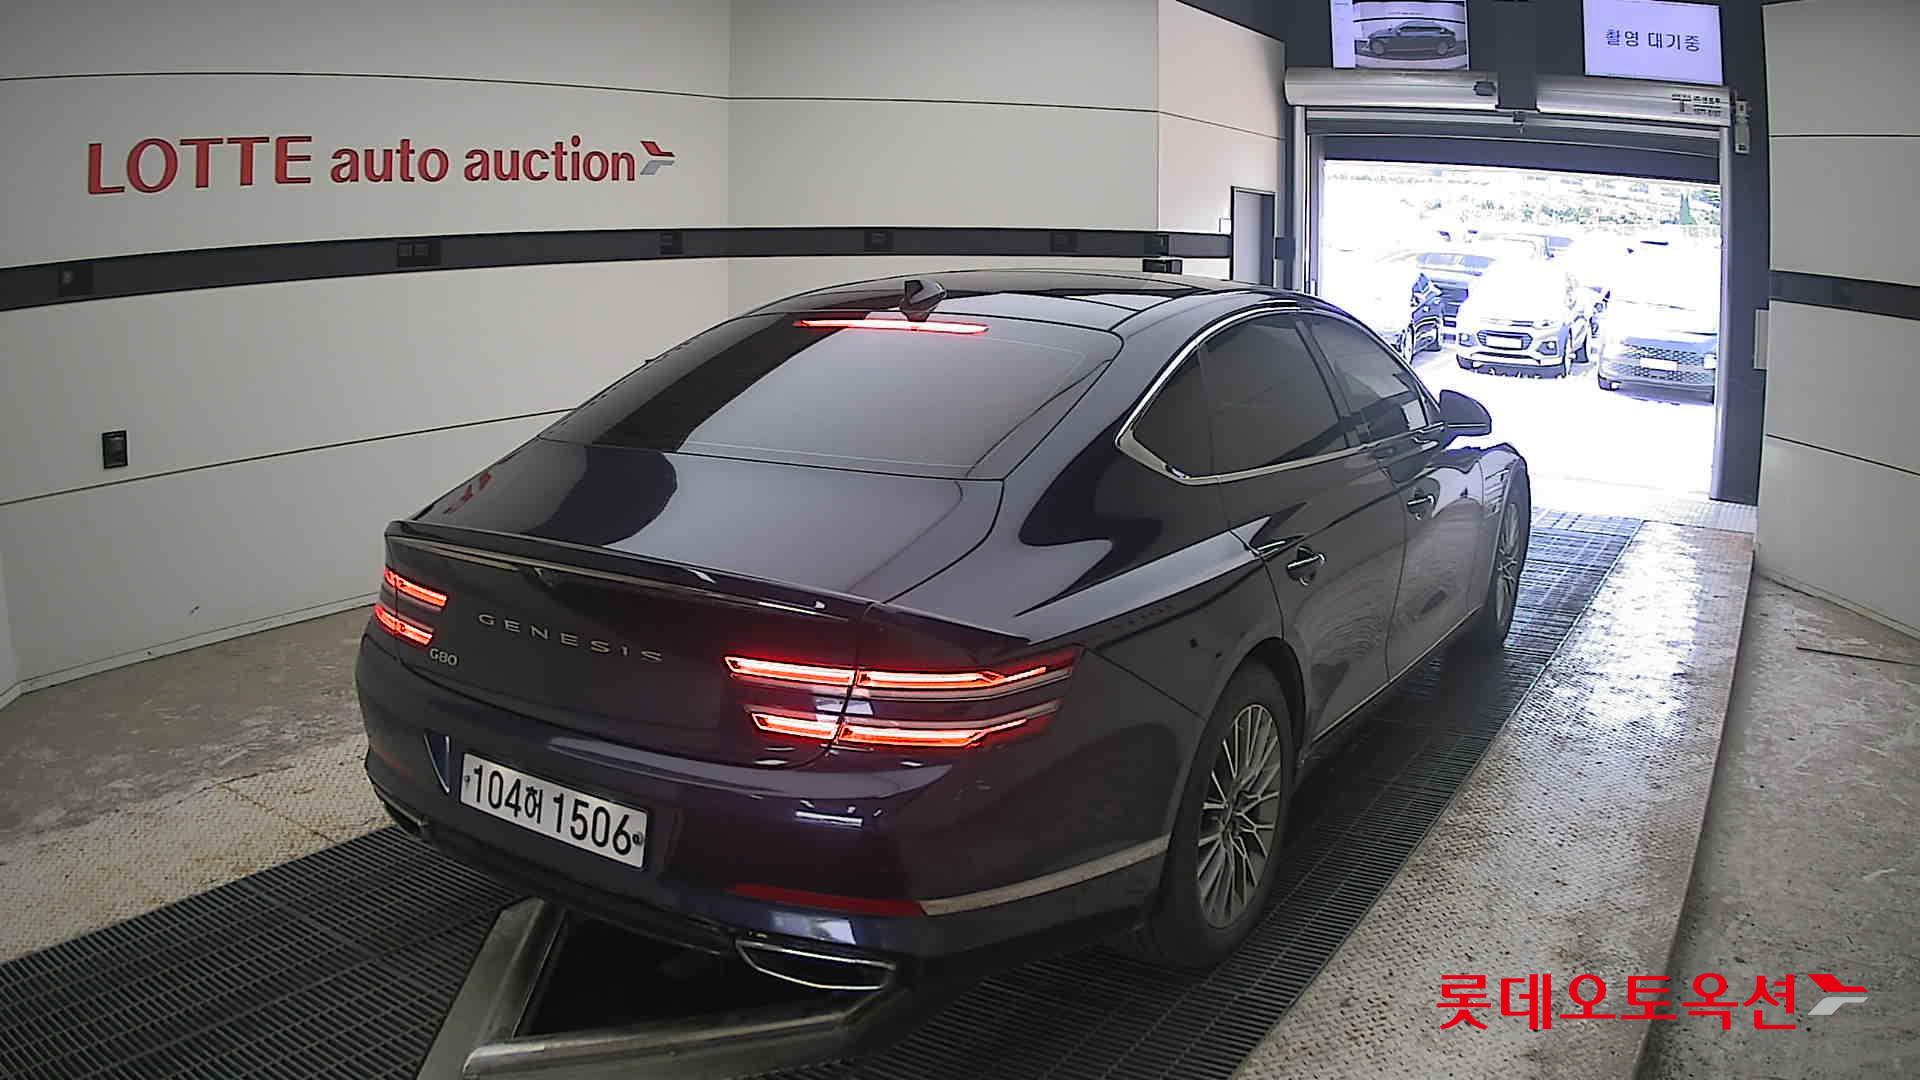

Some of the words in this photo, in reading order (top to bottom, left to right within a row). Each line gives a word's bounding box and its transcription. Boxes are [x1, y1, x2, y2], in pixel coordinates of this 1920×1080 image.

[1605, 29, 1639, 48] 촬영
[1647, 32, 1701, 52] 대기중
[87, 134, 313, 195] LOTTE
[329, 138, 450, 184] auto
[463, 134, 636, 182] auction
[429, 648, 458, 667] G80
[478, 613, 664, 663] GENESIS
[473, 764, 544, 825] 104허
[552, 793, 634, 856] 1506
